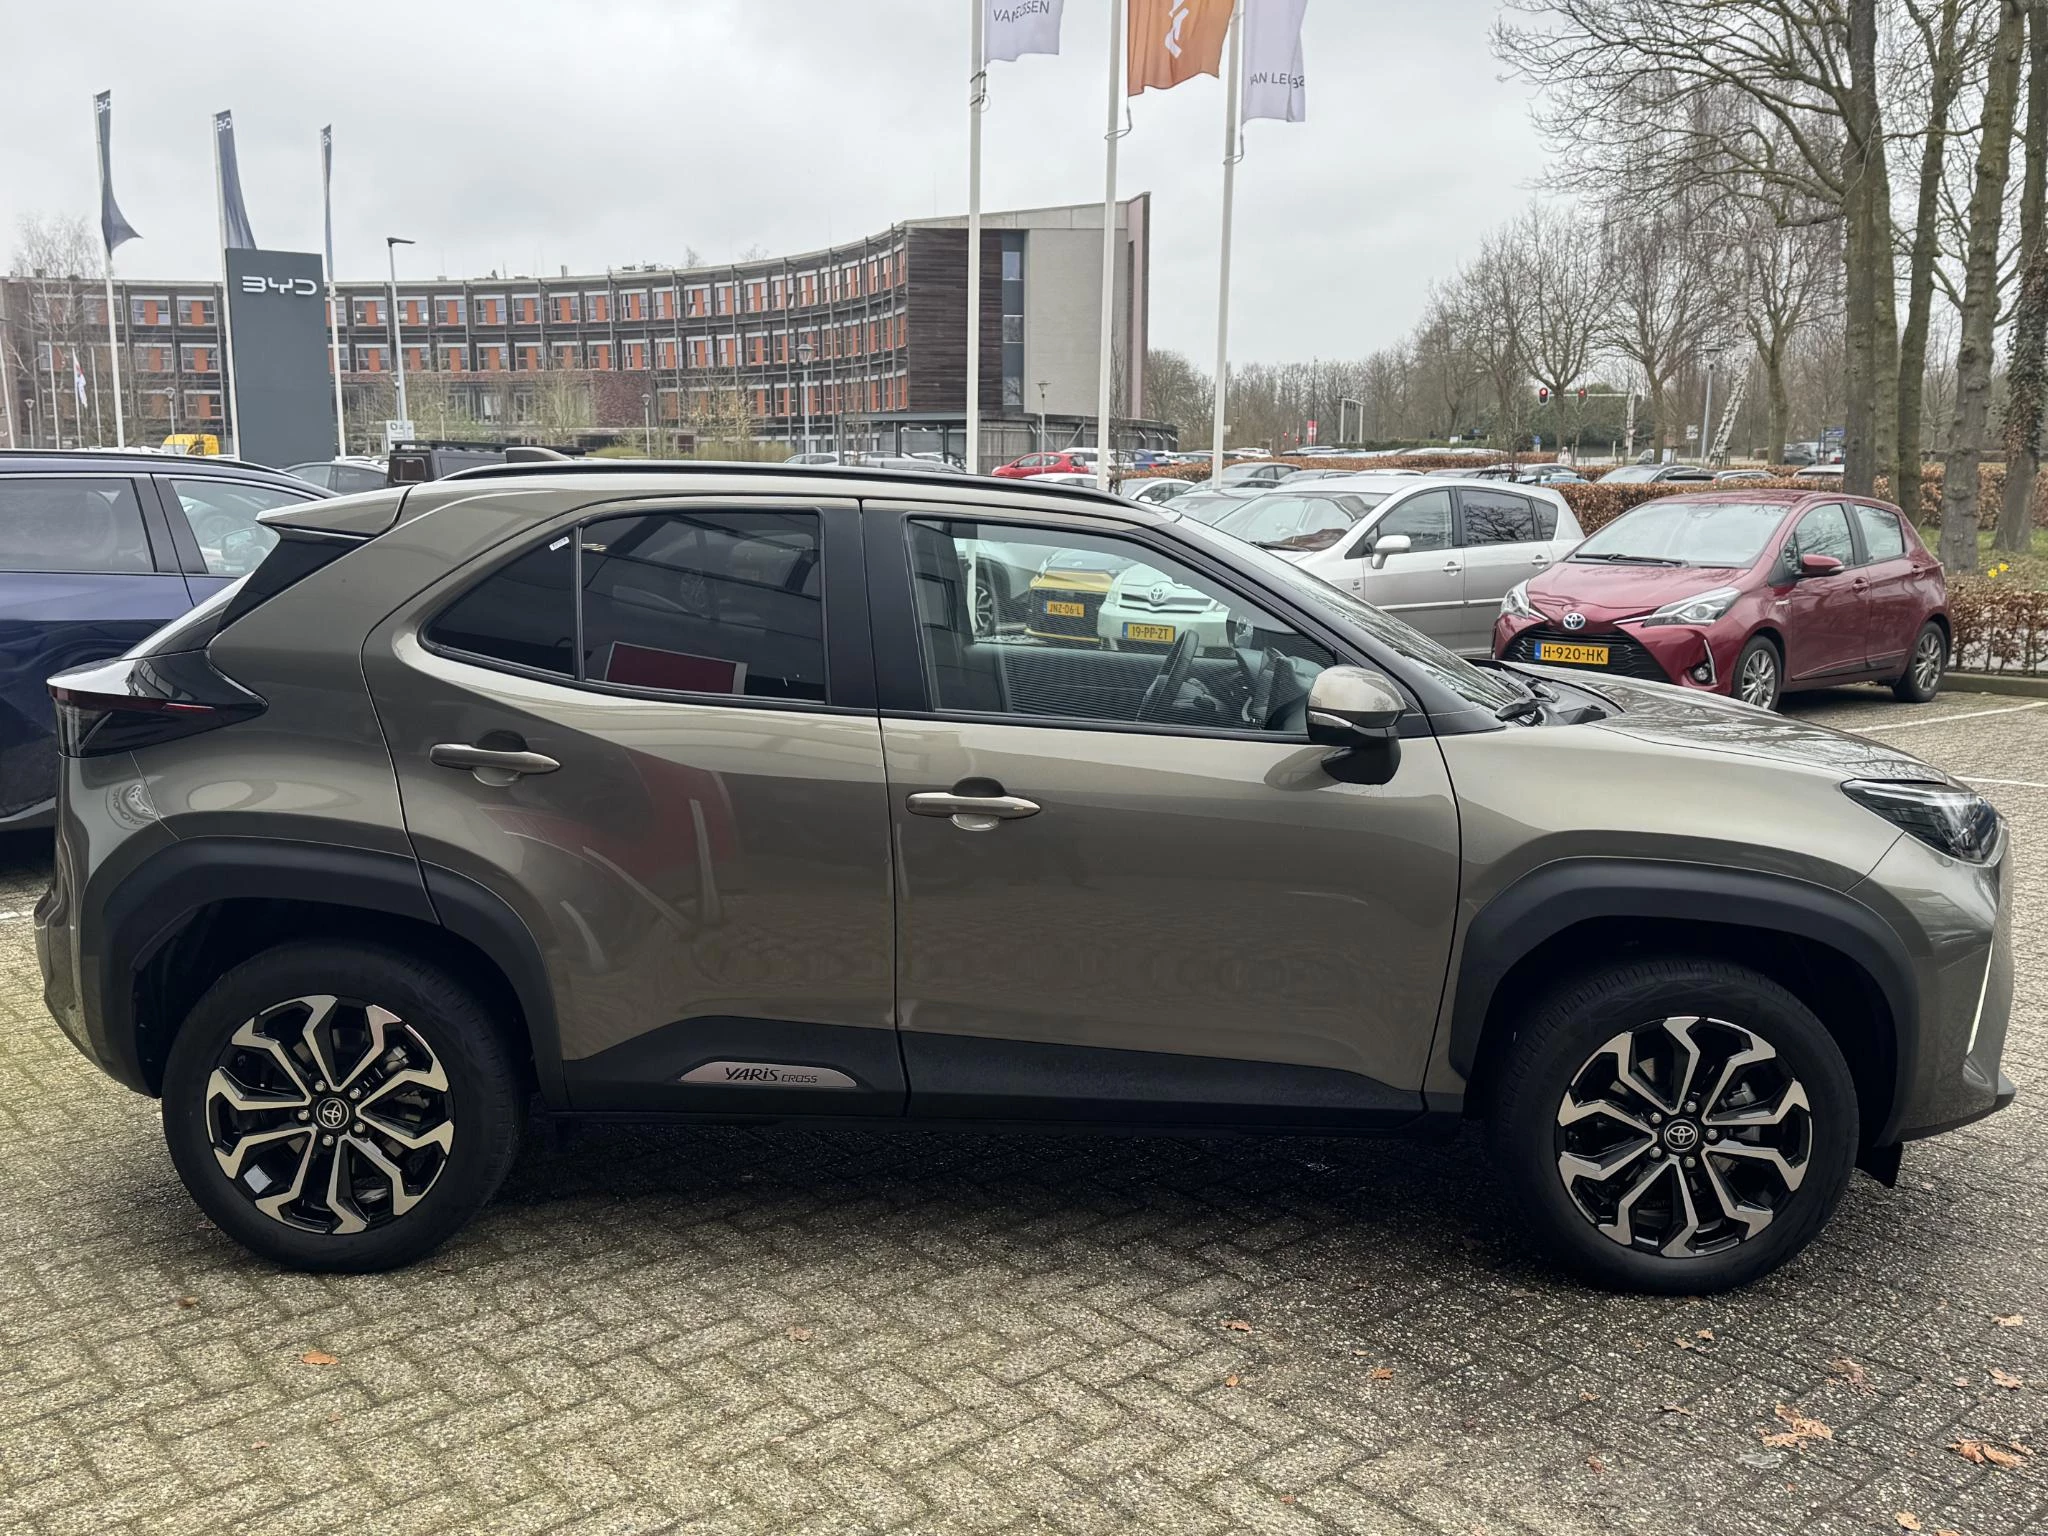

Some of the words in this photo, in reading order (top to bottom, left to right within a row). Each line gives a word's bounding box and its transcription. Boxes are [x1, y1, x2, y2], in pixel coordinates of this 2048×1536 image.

[242, 275, 317, 296] BYD
[1131, 625, 1169, 640] 19-PP-ZT
[1543, 646, 1604, 662] H-920-HK
[781, 1074, 818, 1084] CROSS
